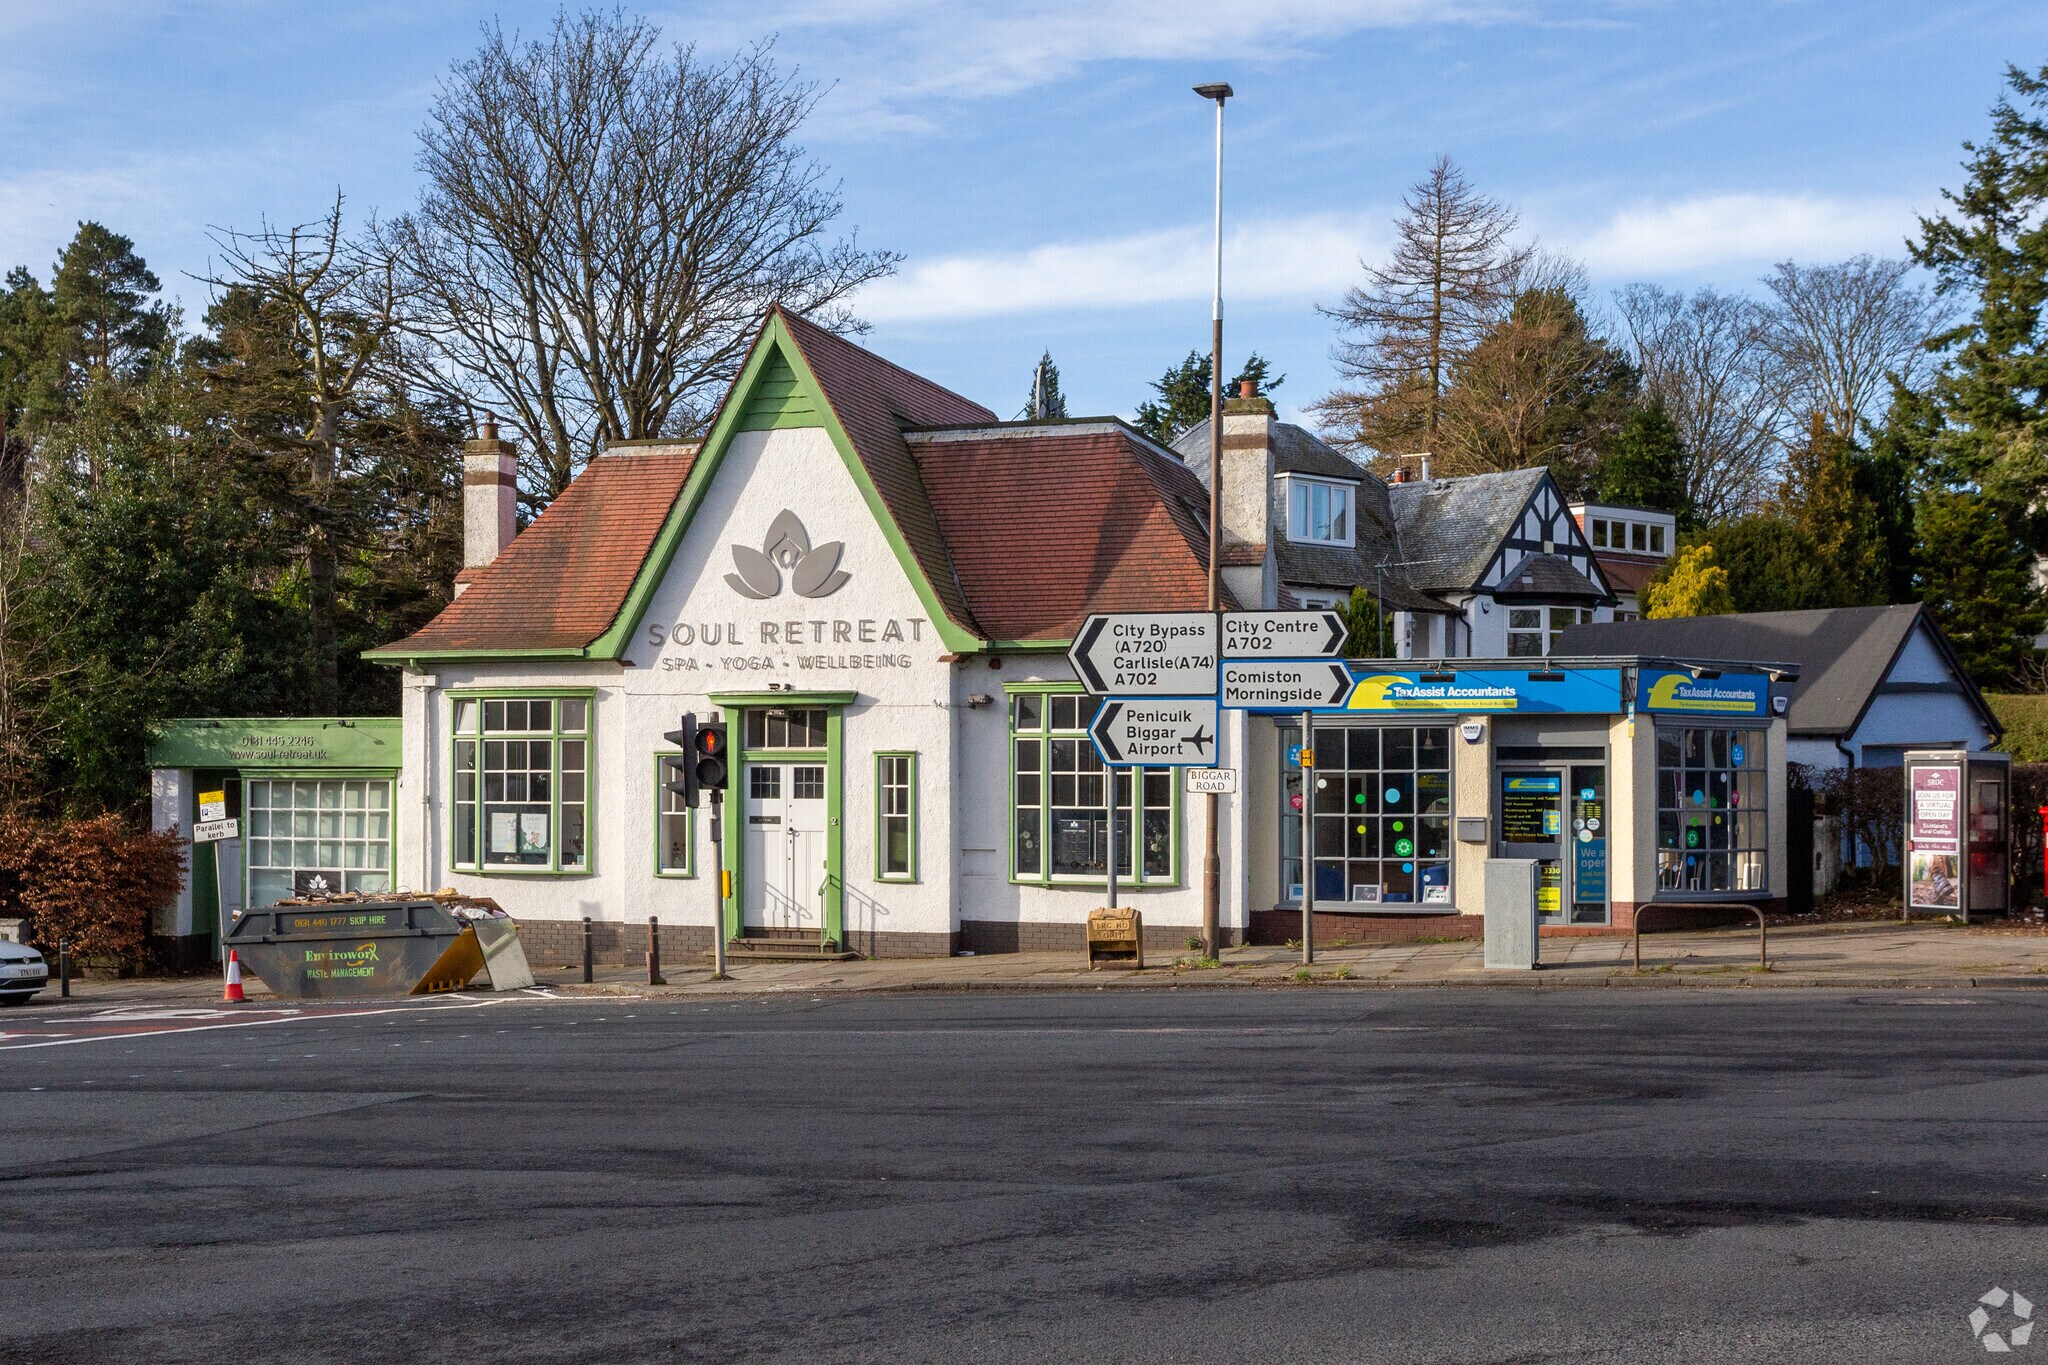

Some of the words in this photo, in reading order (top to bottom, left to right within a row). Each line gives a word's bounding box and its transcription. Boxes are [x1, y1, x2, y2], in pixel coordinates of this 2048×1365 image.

[648, 622, 743, 647] SOUL
[760, 618, 927, 645] RETREAT
[1113, 624, 1145, 639] City
[1150, 624, 1205, 639] Bypass
[1226, 620, 1259, 635] City
[1264, 619, 1318, 633] Centre
[1115, 640, 1167, 654] (A720)
[1227, 637, 1272, 650] A702
[661, 656, 699, 671] SPA
[720, 656, 775, 671] YOGA
[796, 653, 912, 670] WELLBEING
[1114, 672, 1157, 685] A702
[1226, 670, 1301, 683] Comiston
[1226, 687, 1322, 702] Morningside
[1393, 686, 1445, 697] TaxAssist
[1447, 685, 1516, 697] Accountants
[1679, 687, 1712, 698] TaxAssist
[1713, 688, 1756, 700] Accountants
[1127, 709, 1192, 722] Penicuik
[1127, 726, 1176, 741] Biggar
[242, 736, 262, 747] 0131
[266, 736, 285, 746] 445
[287, 736, 314, 746] 2246
[1127, 742, 1183, 757] Airport
[1191, 771, 1231, 780] BIGGAR
[1196, 781, 1225, 791] ROAD
[195, 822, 224, 832] Parallel
[1932, 828, 1952, 836] College
[207, 831, 225, 839] kerb
[1580, 848, 1597, 858] We
[349, 916, 366, 925] SKIP
[369, 915, 387, 924] HIRE
[306, 969, 328, 979] WASTE
[331, 967, 375, 978] MANAGEMENT
